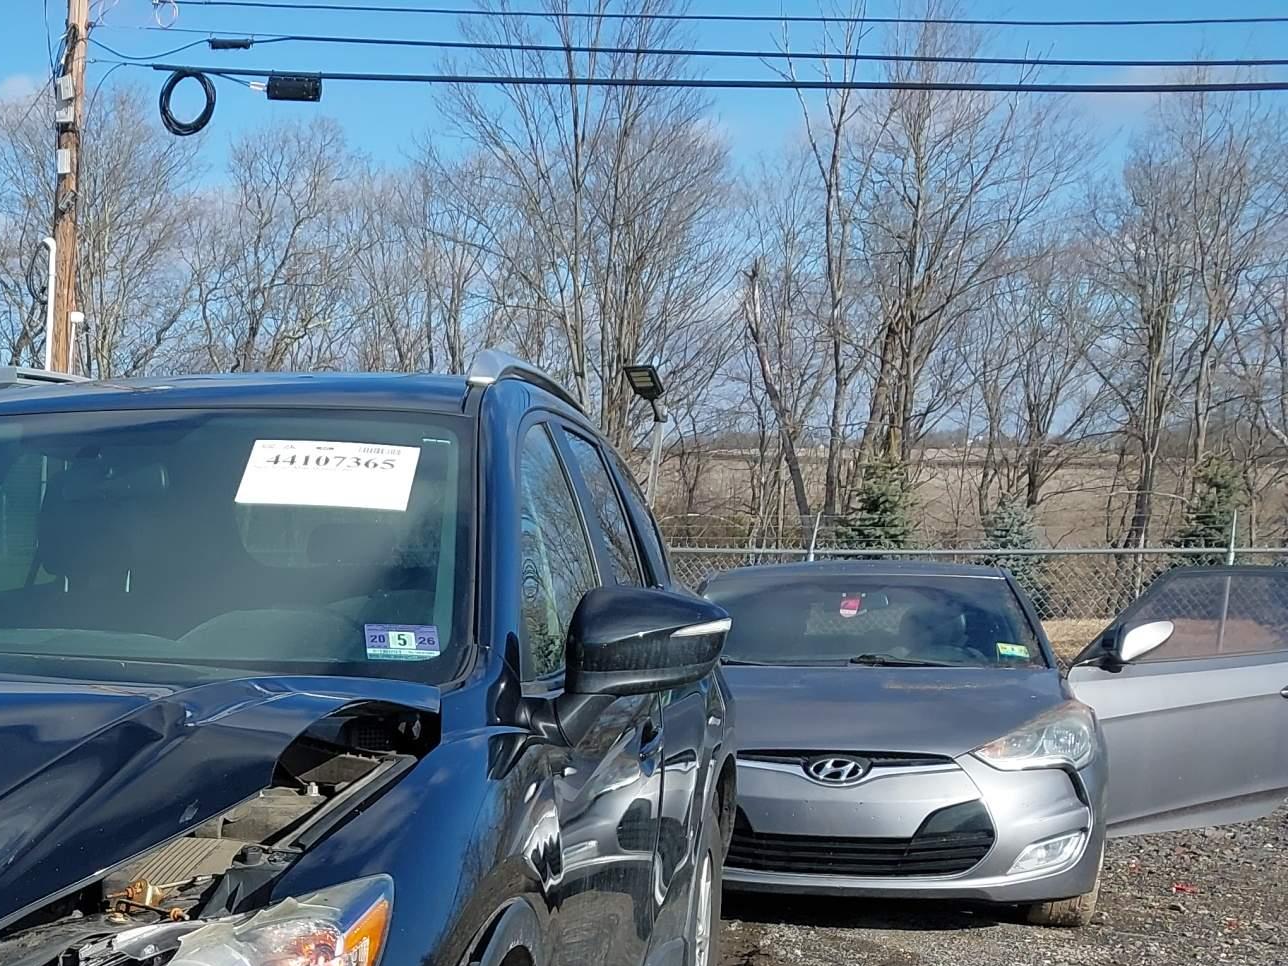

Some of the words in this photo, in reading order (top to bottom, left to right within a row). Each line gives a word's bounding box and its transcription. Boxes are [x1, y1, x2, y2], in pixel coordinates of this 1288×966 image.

[266, 453, 396, 471] 44107365
[370, 634, 386, 644] 20
[397, 633, 407, 647] 5
[418, 636, 436, 646] 26
